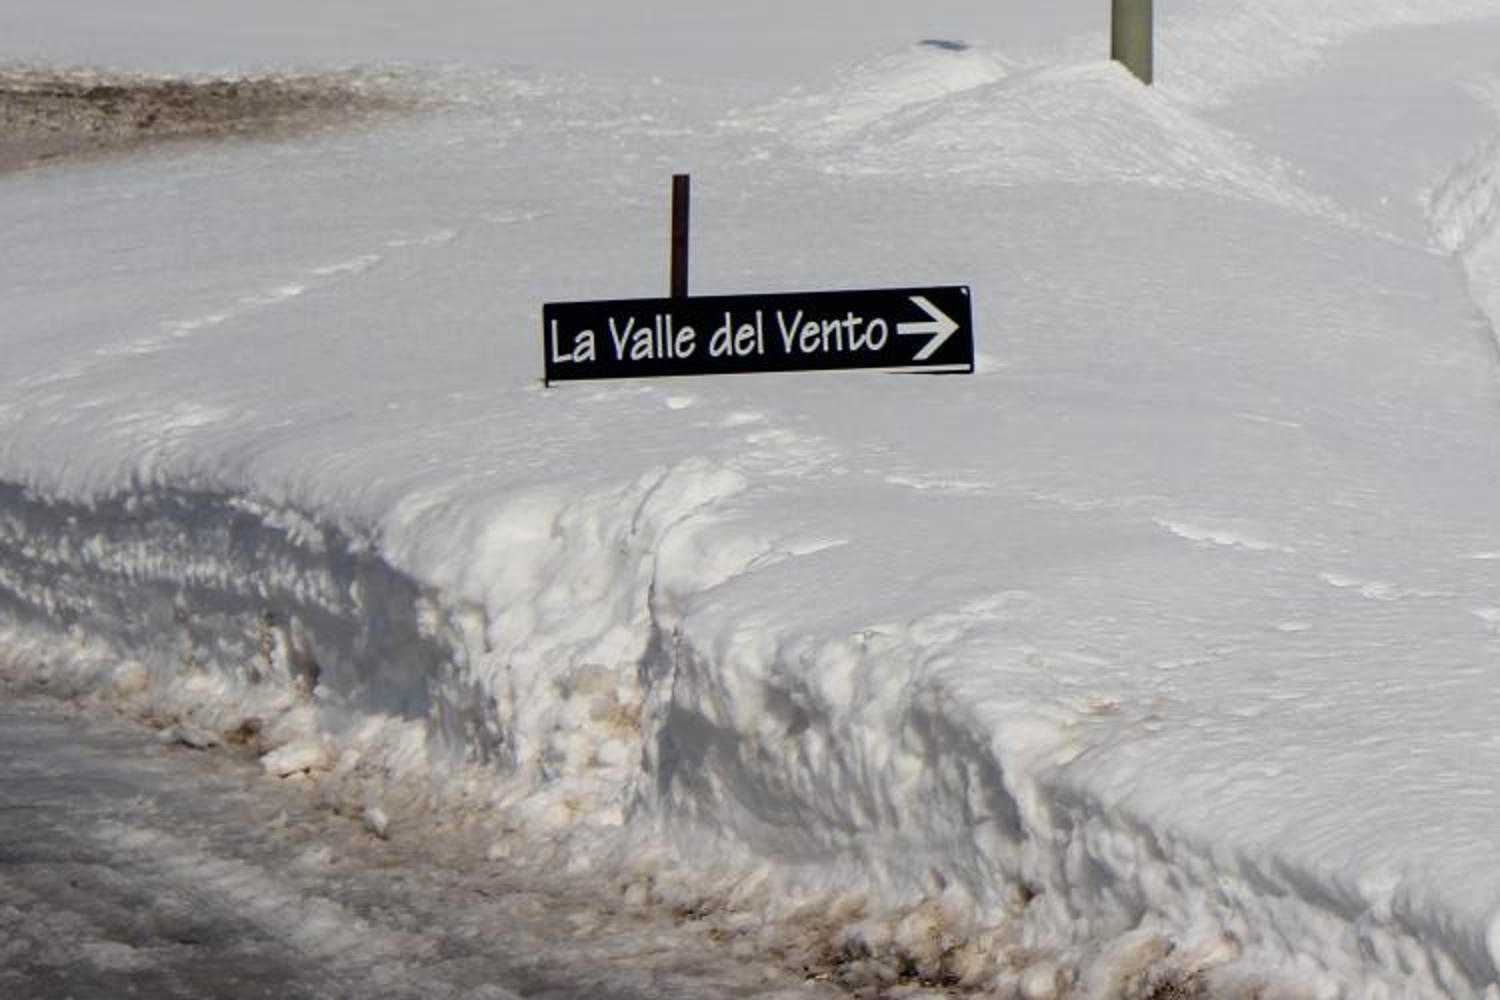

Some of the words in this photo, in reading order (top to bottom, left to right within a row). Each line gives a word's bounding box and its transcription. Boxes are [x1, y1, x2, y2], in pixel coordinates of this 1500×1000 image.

[551, 318, 596, 363] La
[608, 314, 696, 361] Valle
[709, 311, 764, 357] del
[777, 310, 888, 353] Vento
